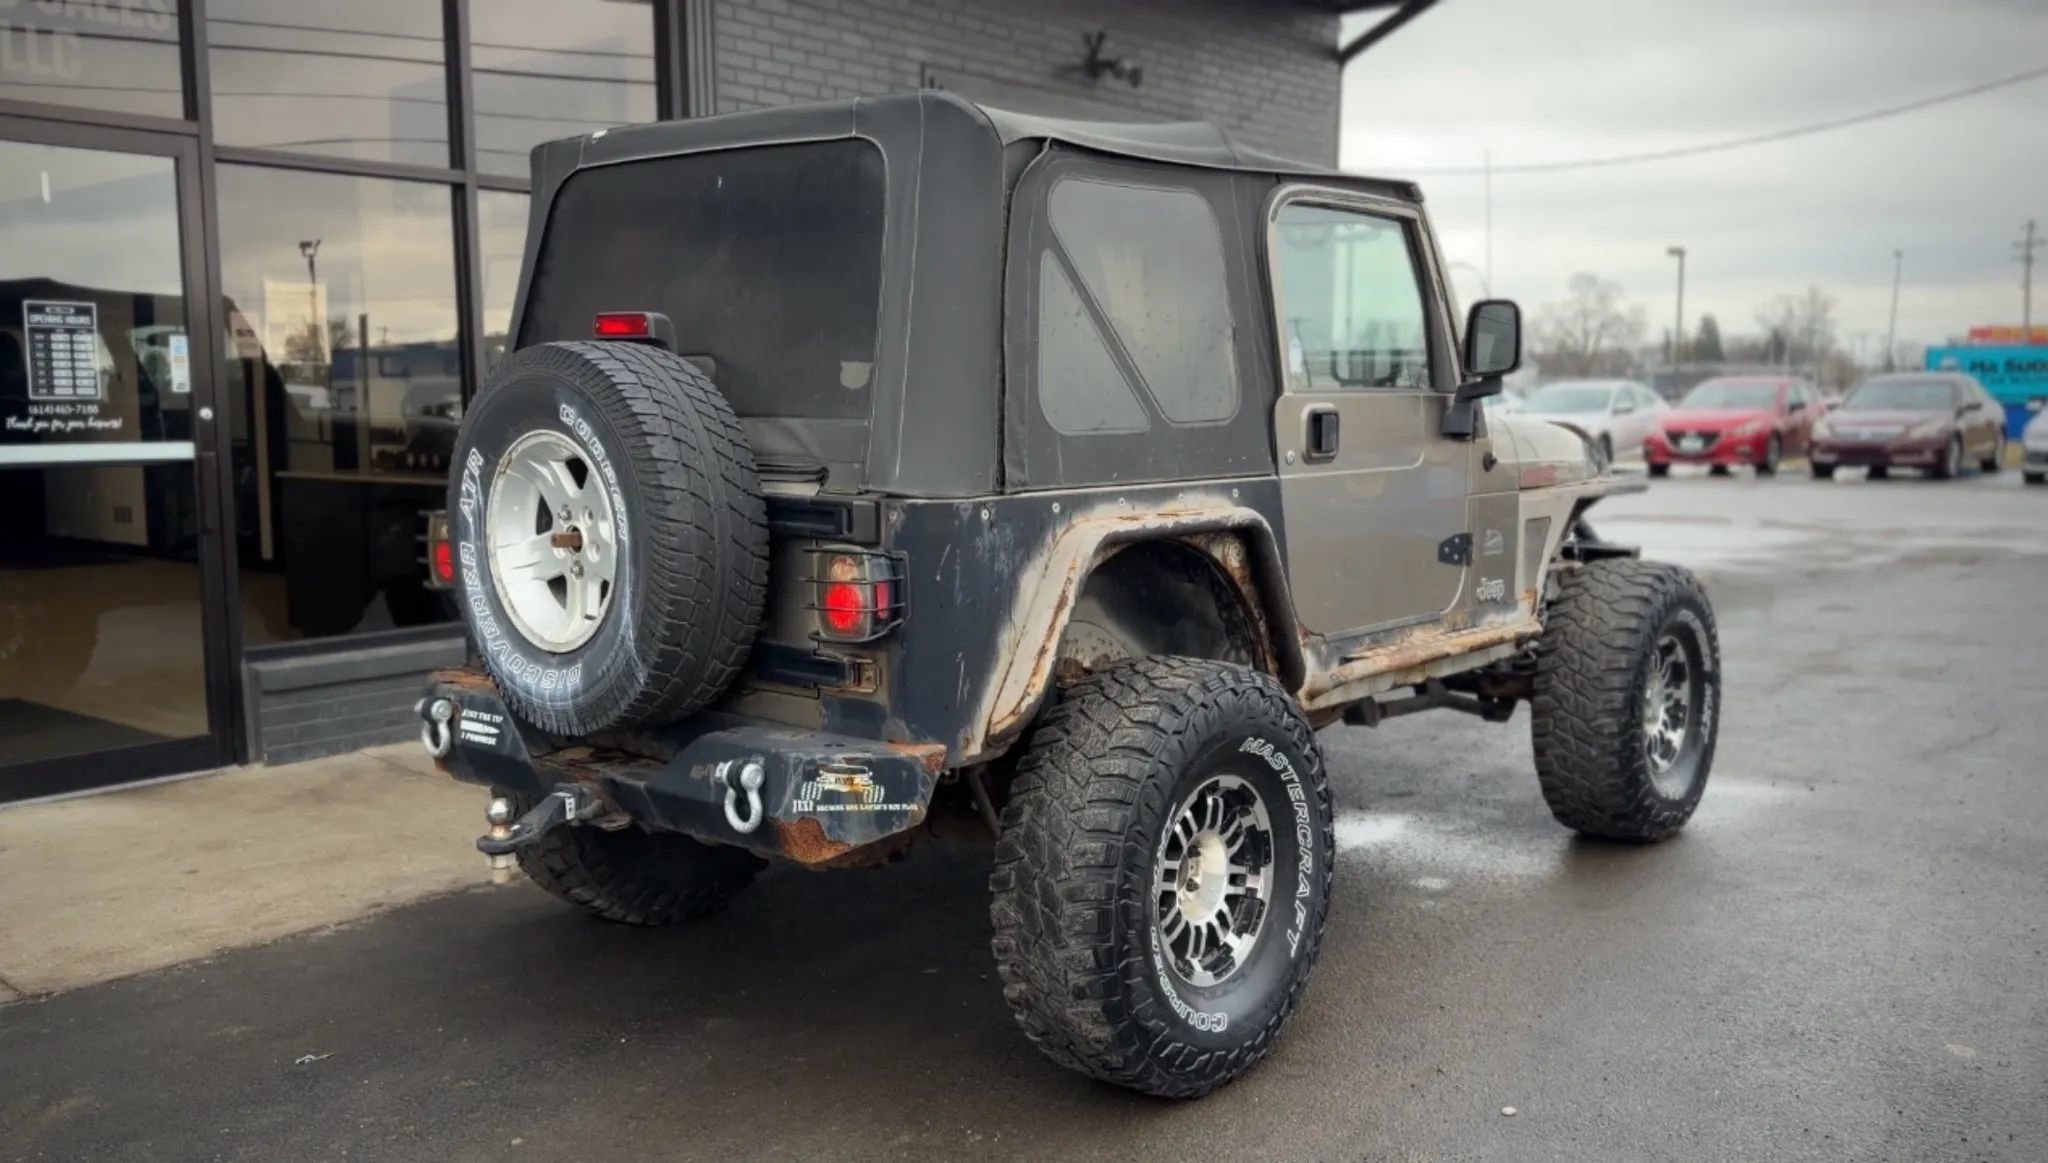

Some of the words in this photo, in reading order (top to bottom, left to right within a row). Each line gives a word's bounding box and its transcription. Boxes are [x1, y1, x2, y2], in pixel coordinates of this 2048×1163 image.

[0, 20, 82, 80] LLC
[29, 313, 63, 324] OPENING
[460, 447, 485, 523] ATR
[1476, 577, 1505, 601] Jeep
[1239, 736, 1313, 958] MASTERCRAFT
